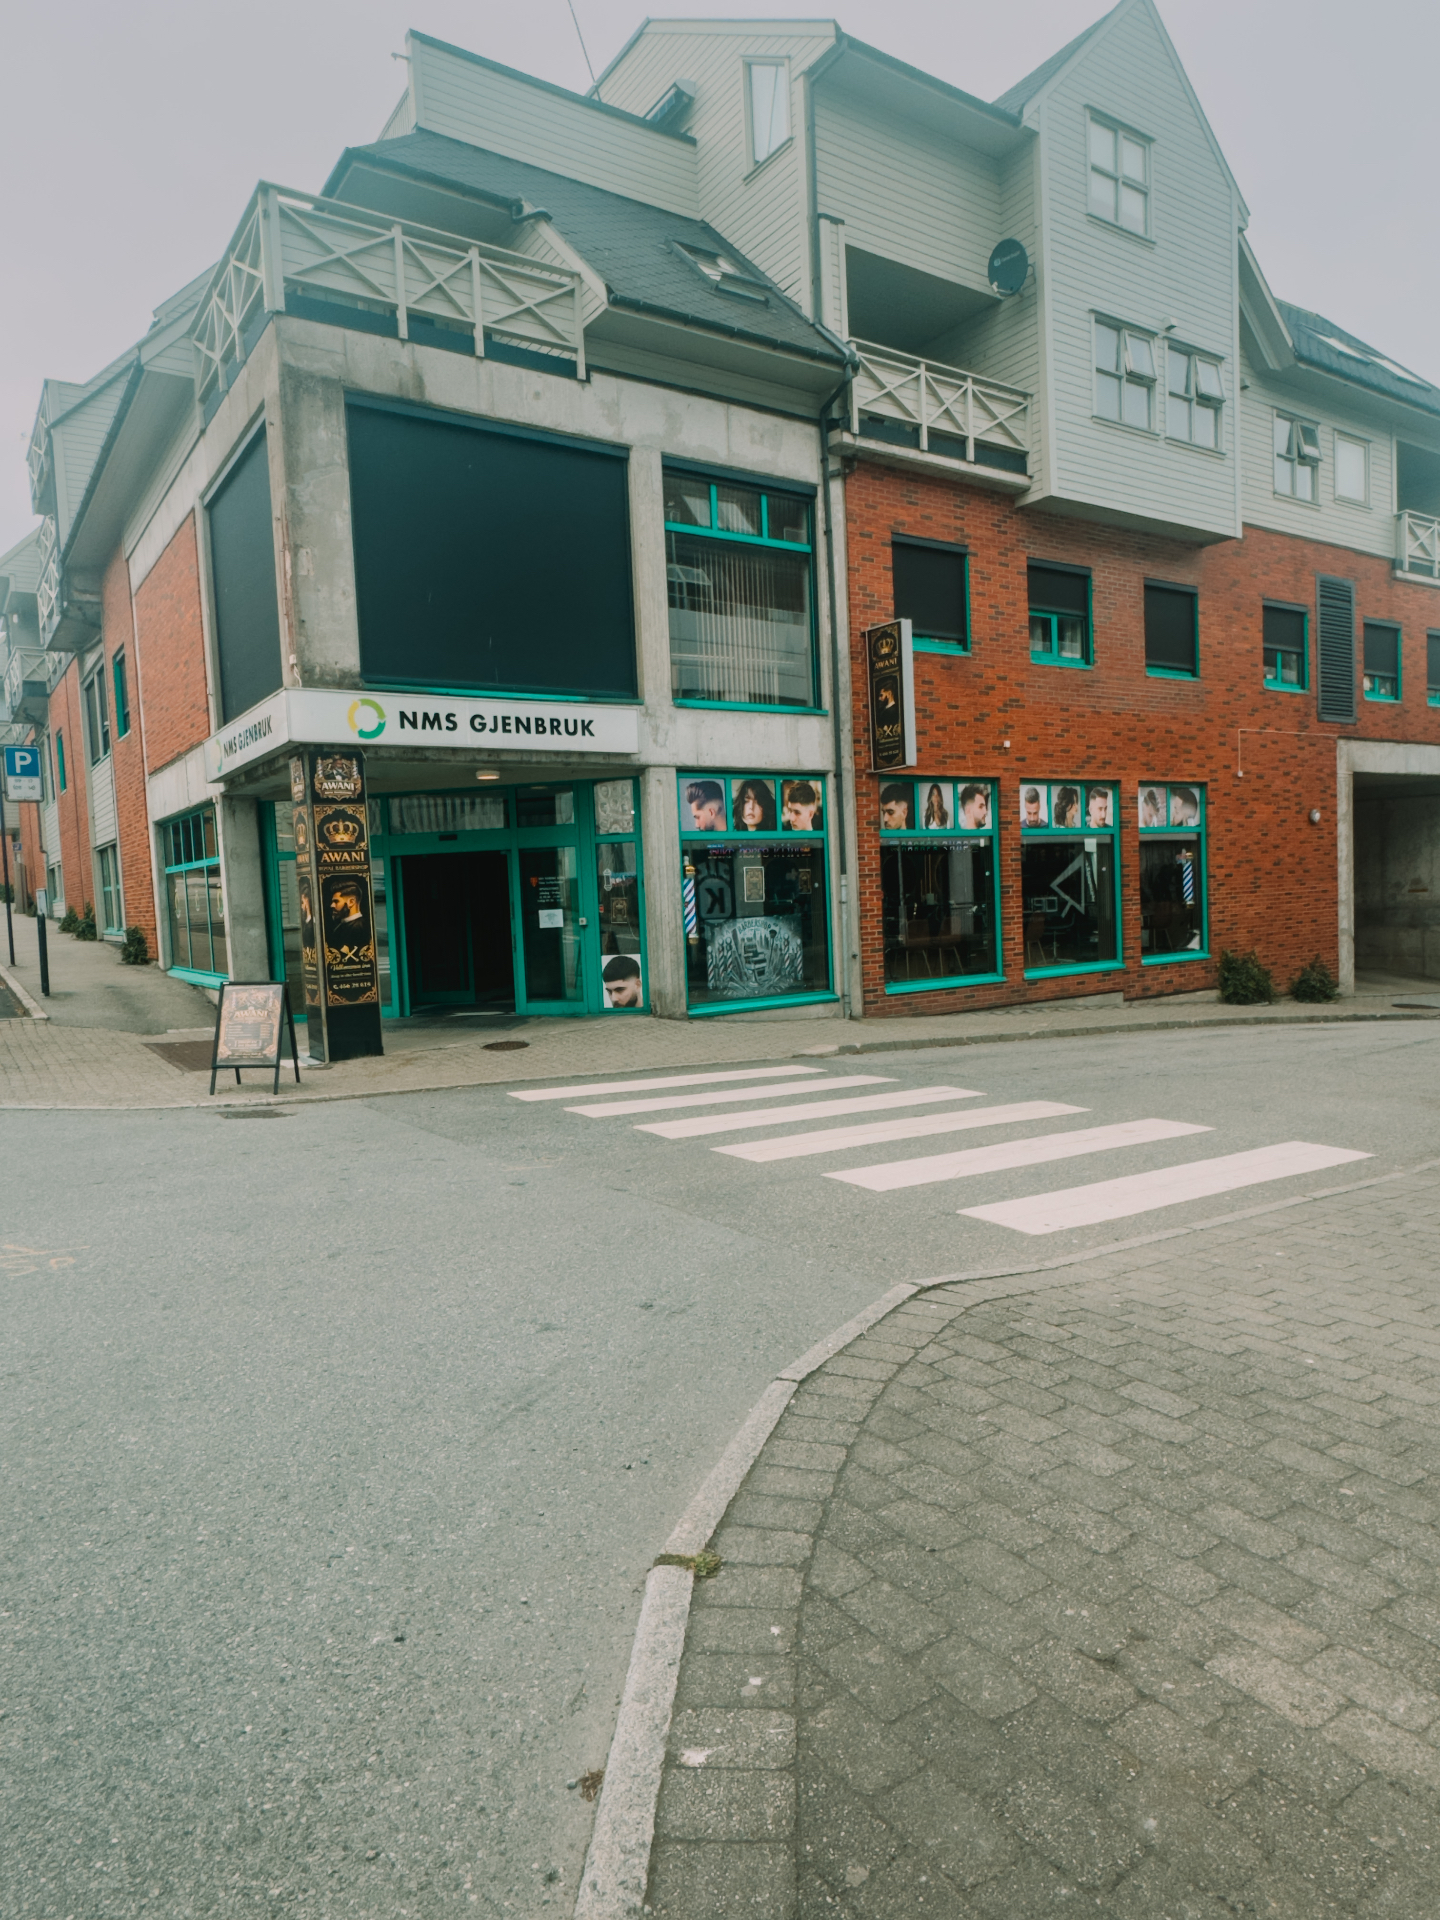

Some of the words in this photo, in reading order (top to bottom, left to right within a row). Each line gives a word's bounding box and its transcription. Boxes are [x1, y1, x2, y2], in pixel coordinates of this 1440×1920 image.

[874, 657, 897, 670] AWANI
[399, 710, 458, 732] NMS
[469, 713, 596, 738] GJENBRUK
[223, 736, 238, 759] NMS
[238, 714, 273, 751] GJENBRUK
[14, 751, 32, 774] P
[321, 781, 355, 791] AWANI
[320, 851, 365, 863] AWANI
[233, 1009, 269, 1018] AWANI
